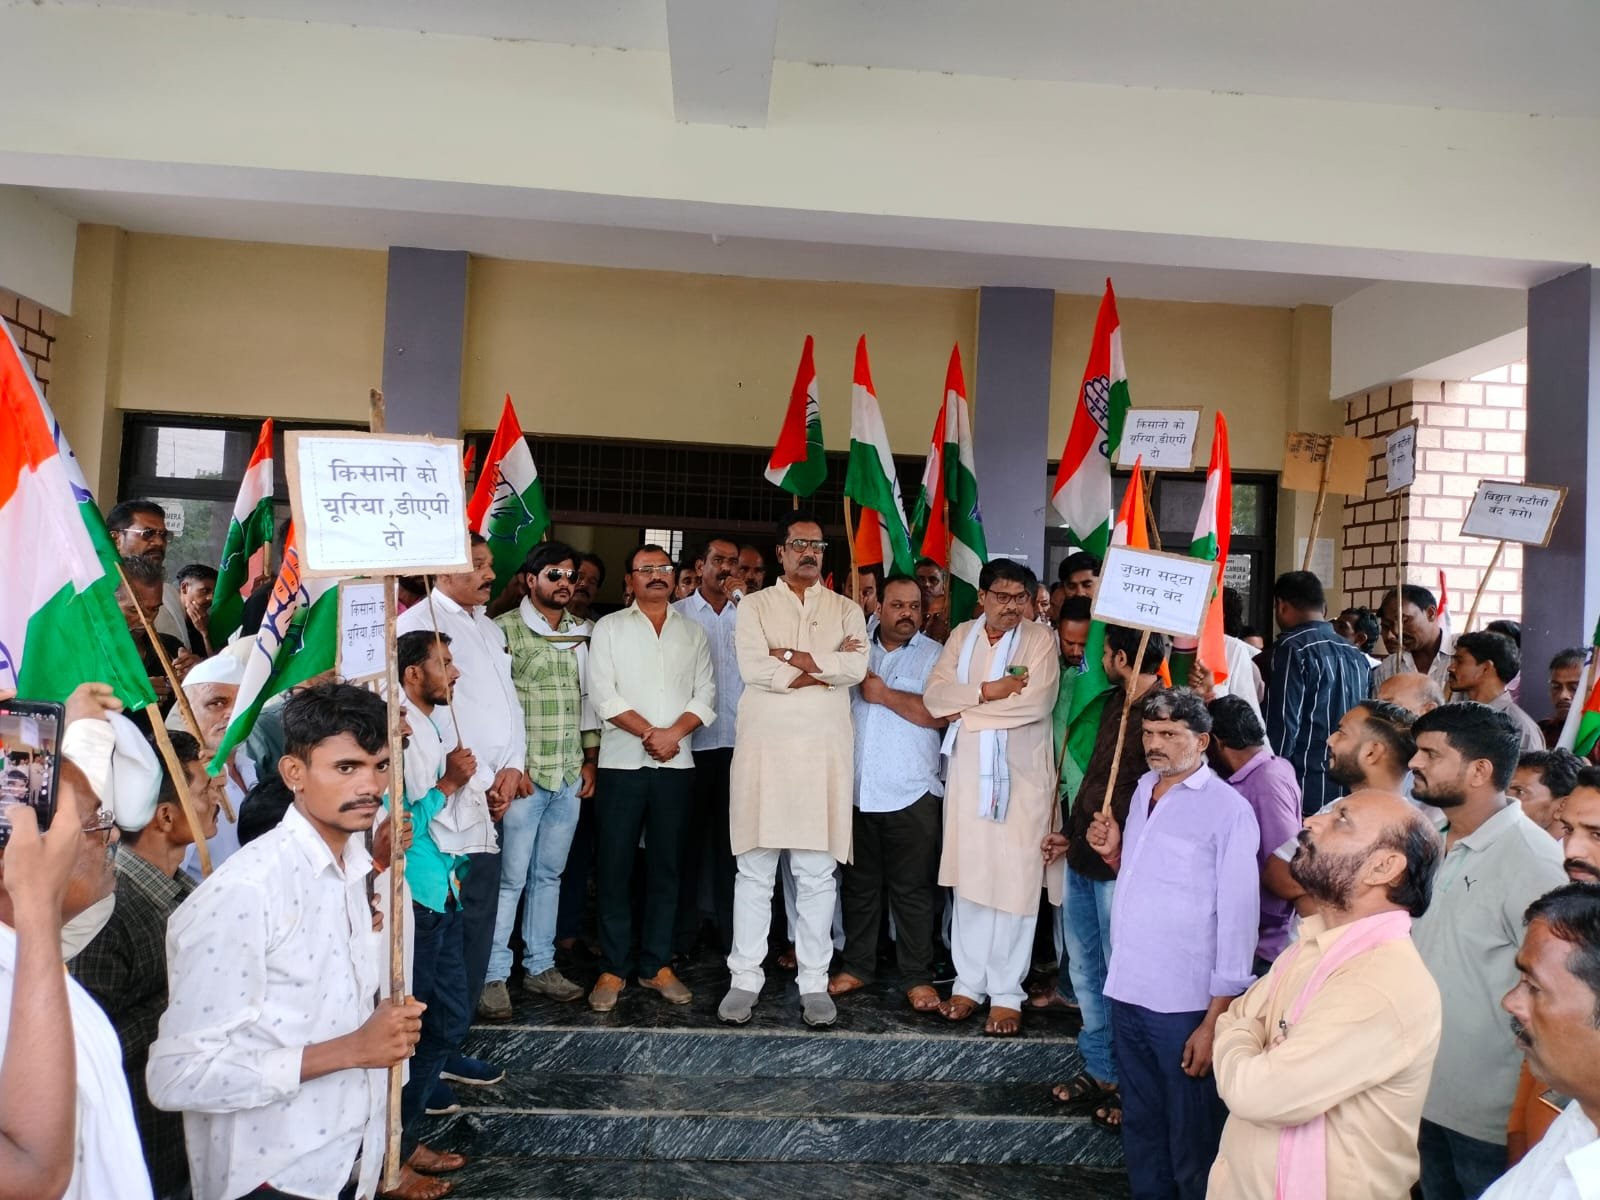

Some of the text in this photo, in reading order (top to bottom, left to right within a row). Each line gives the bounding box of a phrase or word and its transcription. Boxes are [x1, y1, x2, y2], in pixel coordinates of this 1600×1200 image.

[1172, 418, 1185, 430] को
[1150, 446, 1160, 458] दो
[328, 457, 438, 484] किसानो को
[382, 522, 405, 548] दो
[1121, 563, 1152, 578] जुआ
[1163, 587, 1184, 604] बंद
[1136, 600, 1160, 616] करो
